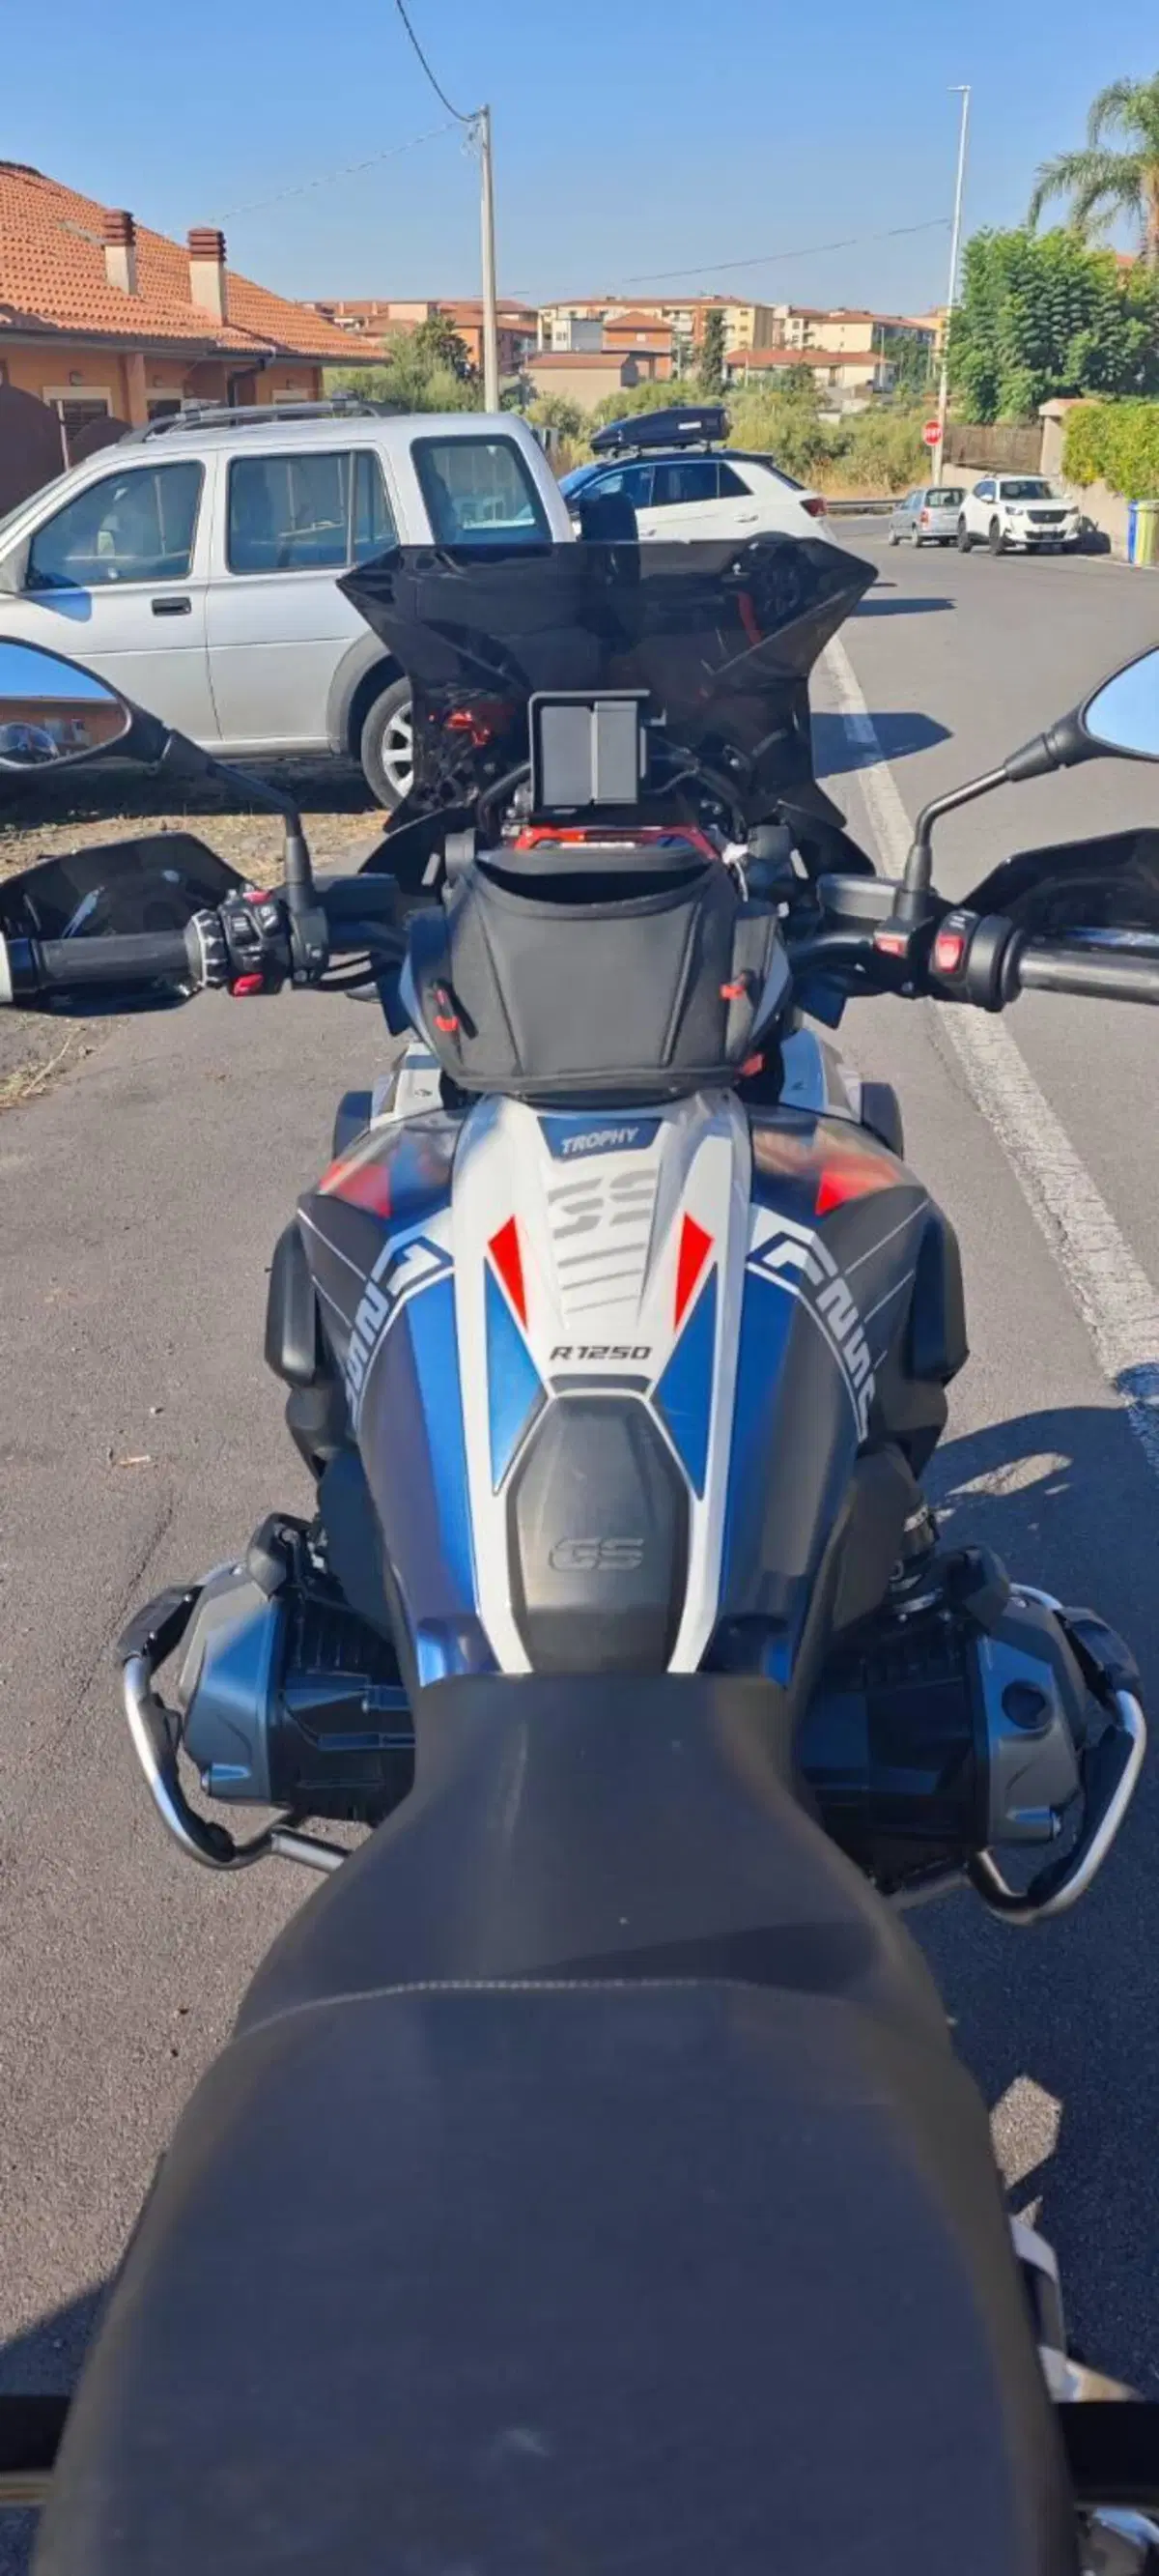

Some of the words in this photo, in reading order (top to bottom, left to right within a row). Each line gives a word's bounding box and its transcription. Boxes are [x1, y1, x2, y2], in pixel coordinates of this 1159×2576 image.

[561, 1127, 639, 1155] TROPHY
[549, 1345, 573, 1360] R
[577, 1345, 652, 1360] 1250
[548, 1537, 644, 1572] GS
